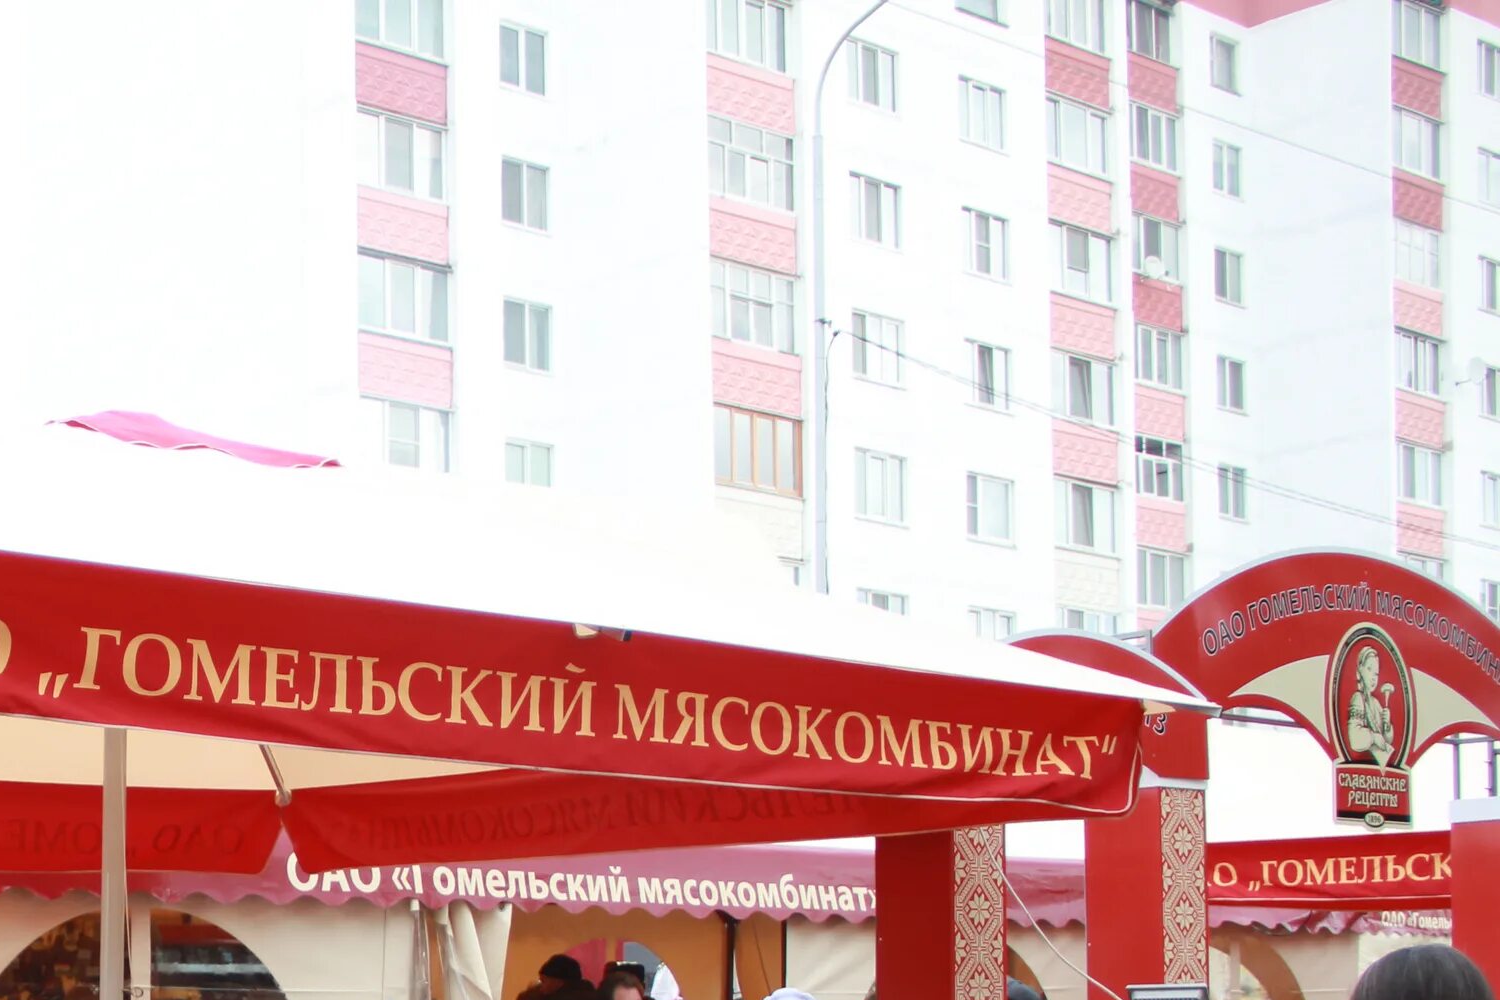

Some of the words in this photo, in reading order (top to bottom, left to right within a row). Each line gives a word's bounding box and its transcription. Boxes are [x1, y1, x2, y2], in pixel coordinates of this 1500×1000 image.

[1202, 610, 1245, 656] ОАО
[1247, 581, 1372, 631] ГОМЕЛЬСКИЙ
[1375, 588, 1500, 686] МЯСОКОМБИН
[1338, 772, 1407, 792] СЛАВЯНСКИЕ
[1348, 790, 1398, 808] РЕЦЕПТЫ
[286, 852, 381, 893] ОАО
